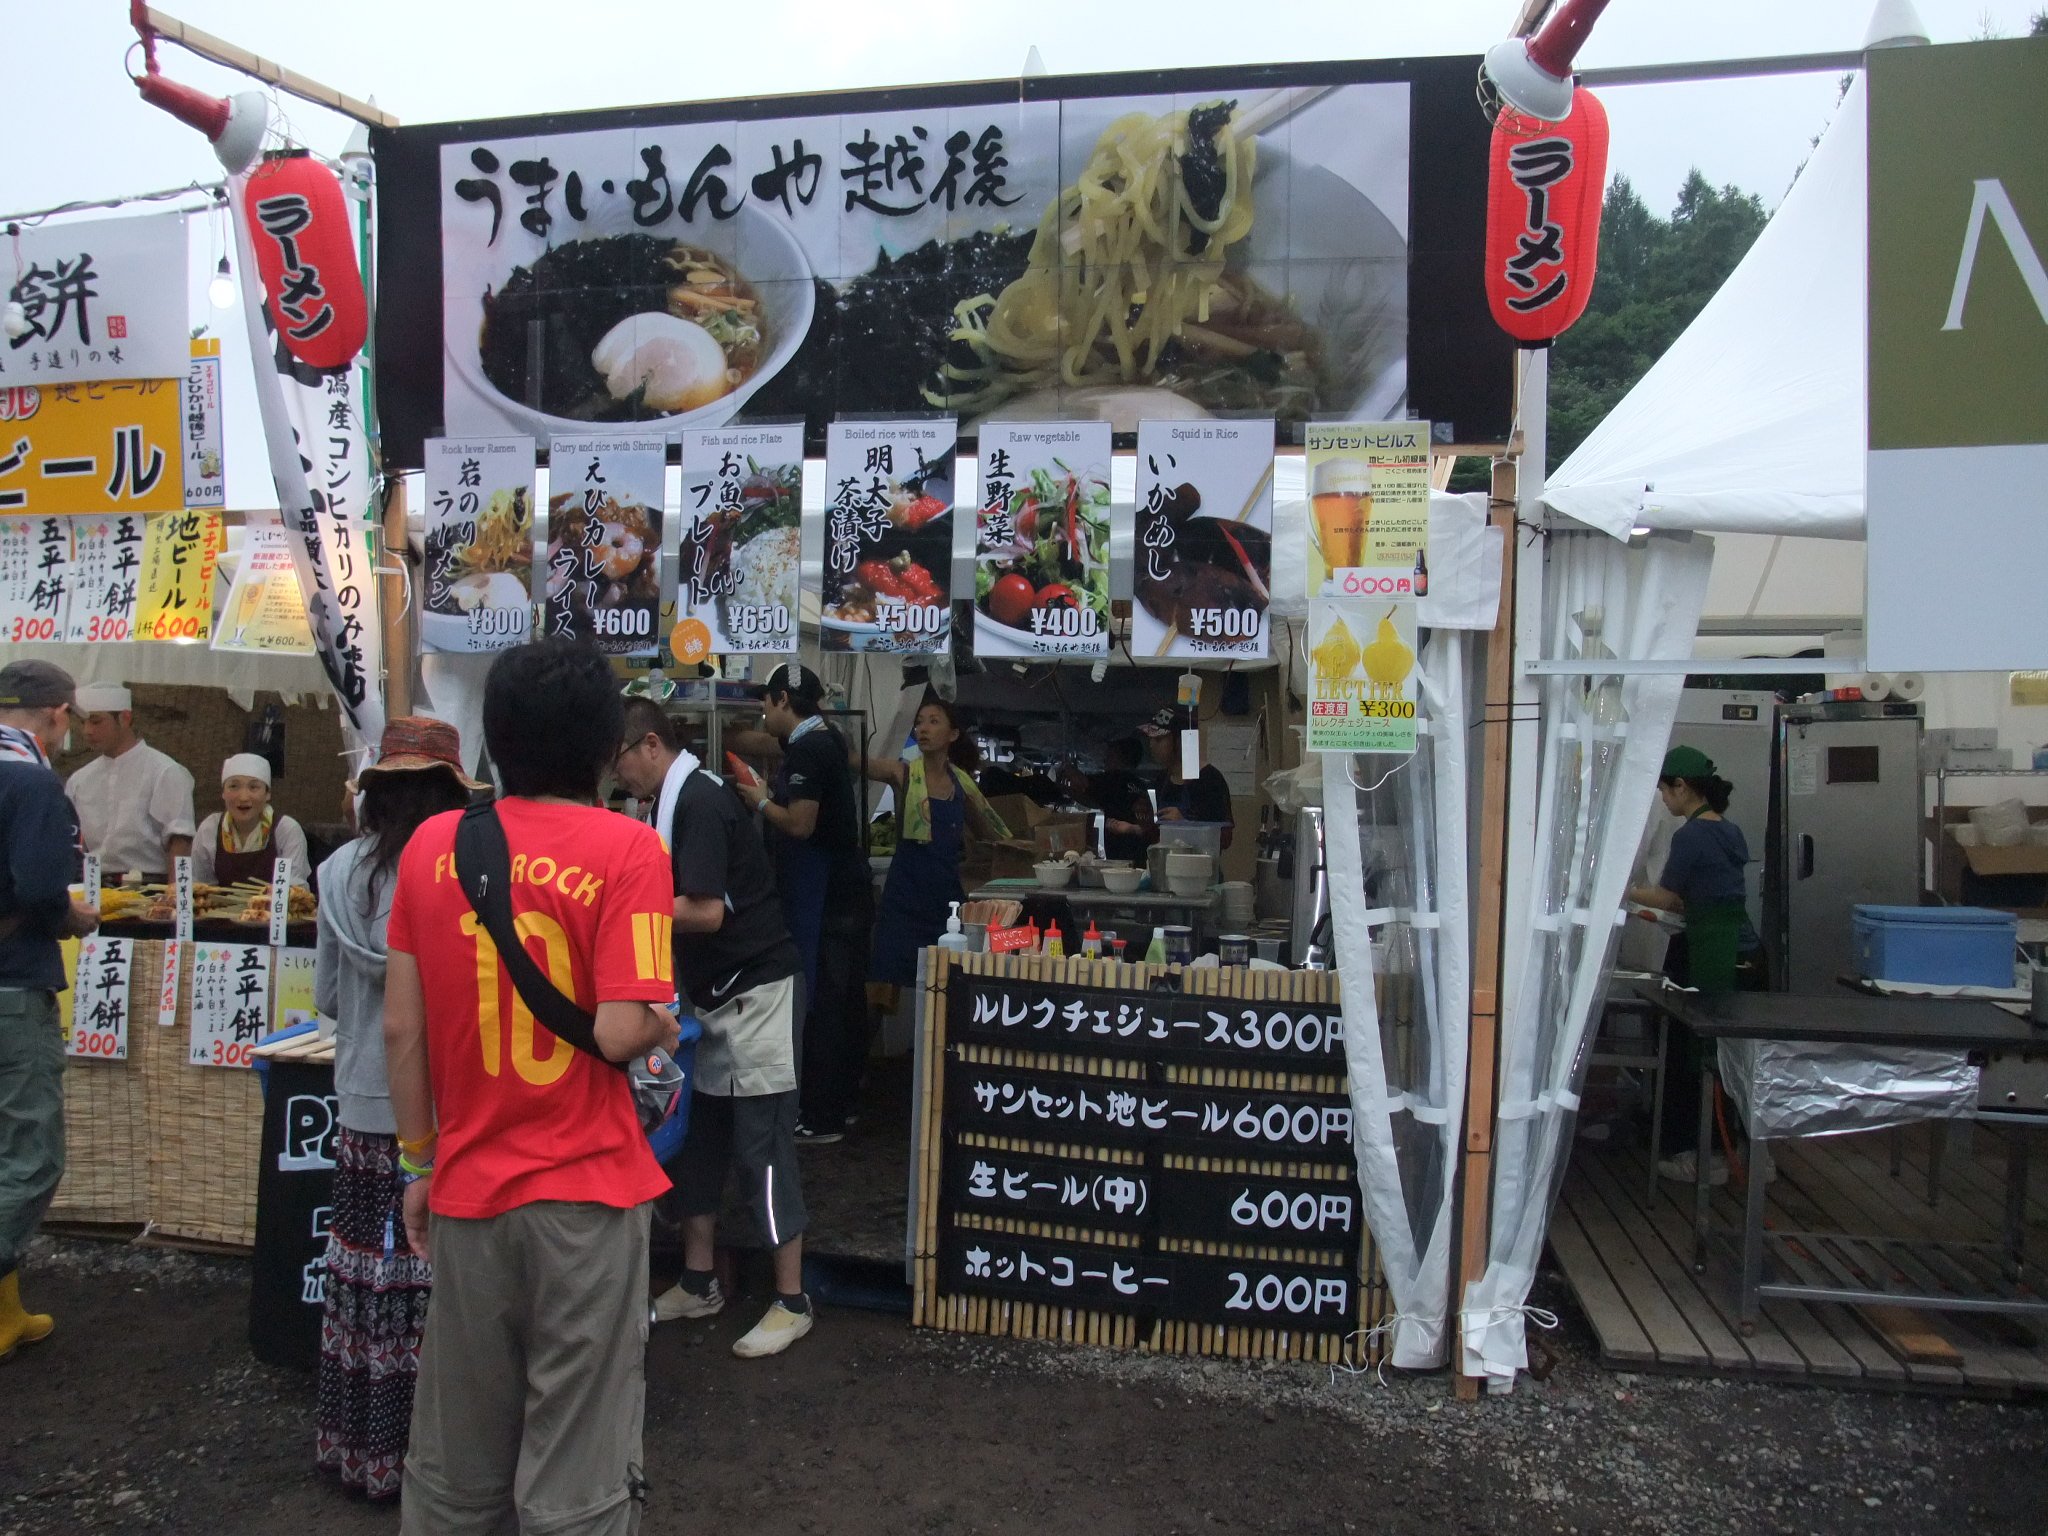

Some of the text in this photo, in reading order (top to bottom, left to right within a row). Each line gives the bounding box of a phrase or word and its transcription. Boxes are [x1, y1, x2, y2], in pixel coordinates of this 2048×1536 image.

[456, 125, 1028, 247] うまいもんや越後
[1506, 138, 1572, 312] ラーメン
[256, 194, 334, 342] ラーメン
[441, 444, 462, 455] Rock
[487, 444, 516, 454] Ramen
[554, 440, 663, 454] Curry and rice with Shrimp
[701, 434, 782, 446] Fish and rice Plate
[845, 429, 936, 440] Boiled rice with tea
[1009, 431, 1080, 445] Raw vegetable
[1171, 428, 1239, 440] Squid in Rice
[186, 485, 222, 498] 600円
[458, 457, 481, 548] 岩のり
[715, 450, 745, 512] お魚
[861, 444, 893, 542] 明太子
[984, 448, 1016, 546] 生野菜
[430, 490, 455, 609] ラーメン
[581, 456, 609, 609] えびカレー
[689, 480, 713, 606] プレート
[831, 477, 864, 573] 茶漬け
[1144, 453, 1176, 581] いかめし
[27, 517, 66, 616] 五平餅
[103, 516, 142, 619] 五平餅
[166, 511, 200, 610] 地ビール
[551, 548, 580, 641] ライス
[1343, 572, 1411, 595] 600円
[467, 607, 524, 635] ¥800
[592, 608, 651, 636] ¥600
[728, 605, 789, 634] ¥650
[875, 605, 941, 634] ¥500
[1031, 608, 1098, 636] ¥400
[1190, 608, 1259, 637] ¥500
[1360, 700, 1415, 719] ¥300
[511, 853, 605, 907] ROCK
[88, 939, 126, 1035] 五平餅
[228, 947, 266, 1044] 五平餅
[459, 910, 577, 1086] 10
[1230, 1188, 1352, 1232] 600円
[965, 1245, 1347, 1315] ホットコーヒー 200円
